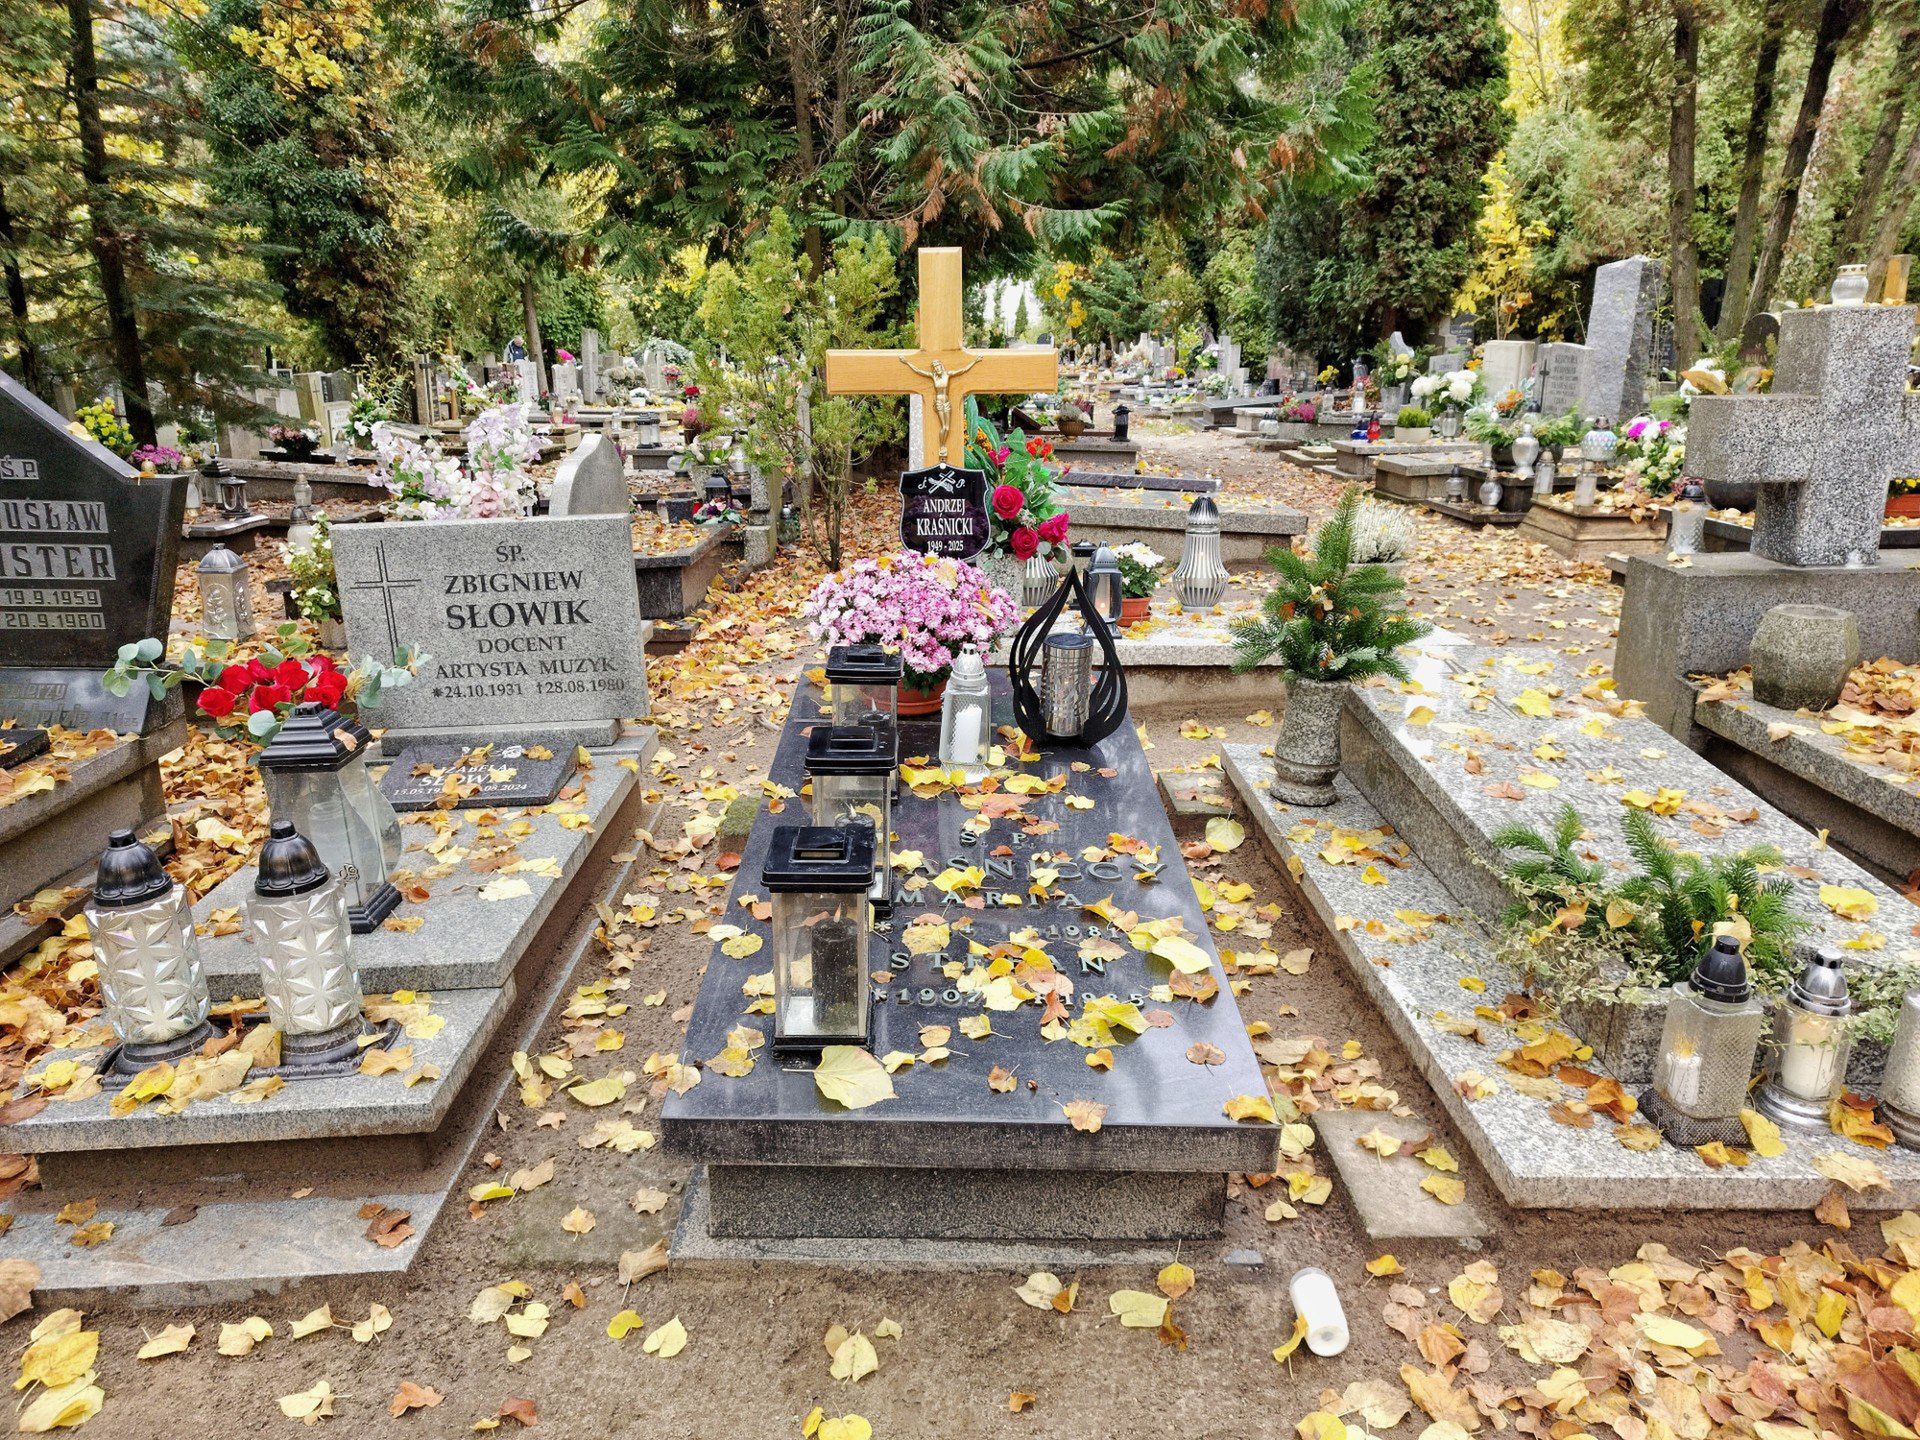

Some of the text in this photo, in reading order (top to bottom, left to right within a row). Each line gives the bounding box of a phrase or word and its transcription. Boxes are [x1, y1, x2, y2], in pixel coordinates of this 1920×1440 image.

[924, 498, 966, 515] ANDRZEJ
[917, 513, 973, 536] KRAŚNICKI
[927, 541, 943, 551] 1949
[444, 569, 584, 595] ZBIGNIEW
[446, 599, 593, 630] SŁOWIK
[477, 635, 567, 655] DOCENT
[436, 657, 619, 680] ARTYSTA MUZYK
[894, 888, 1084, 908] MARIA
